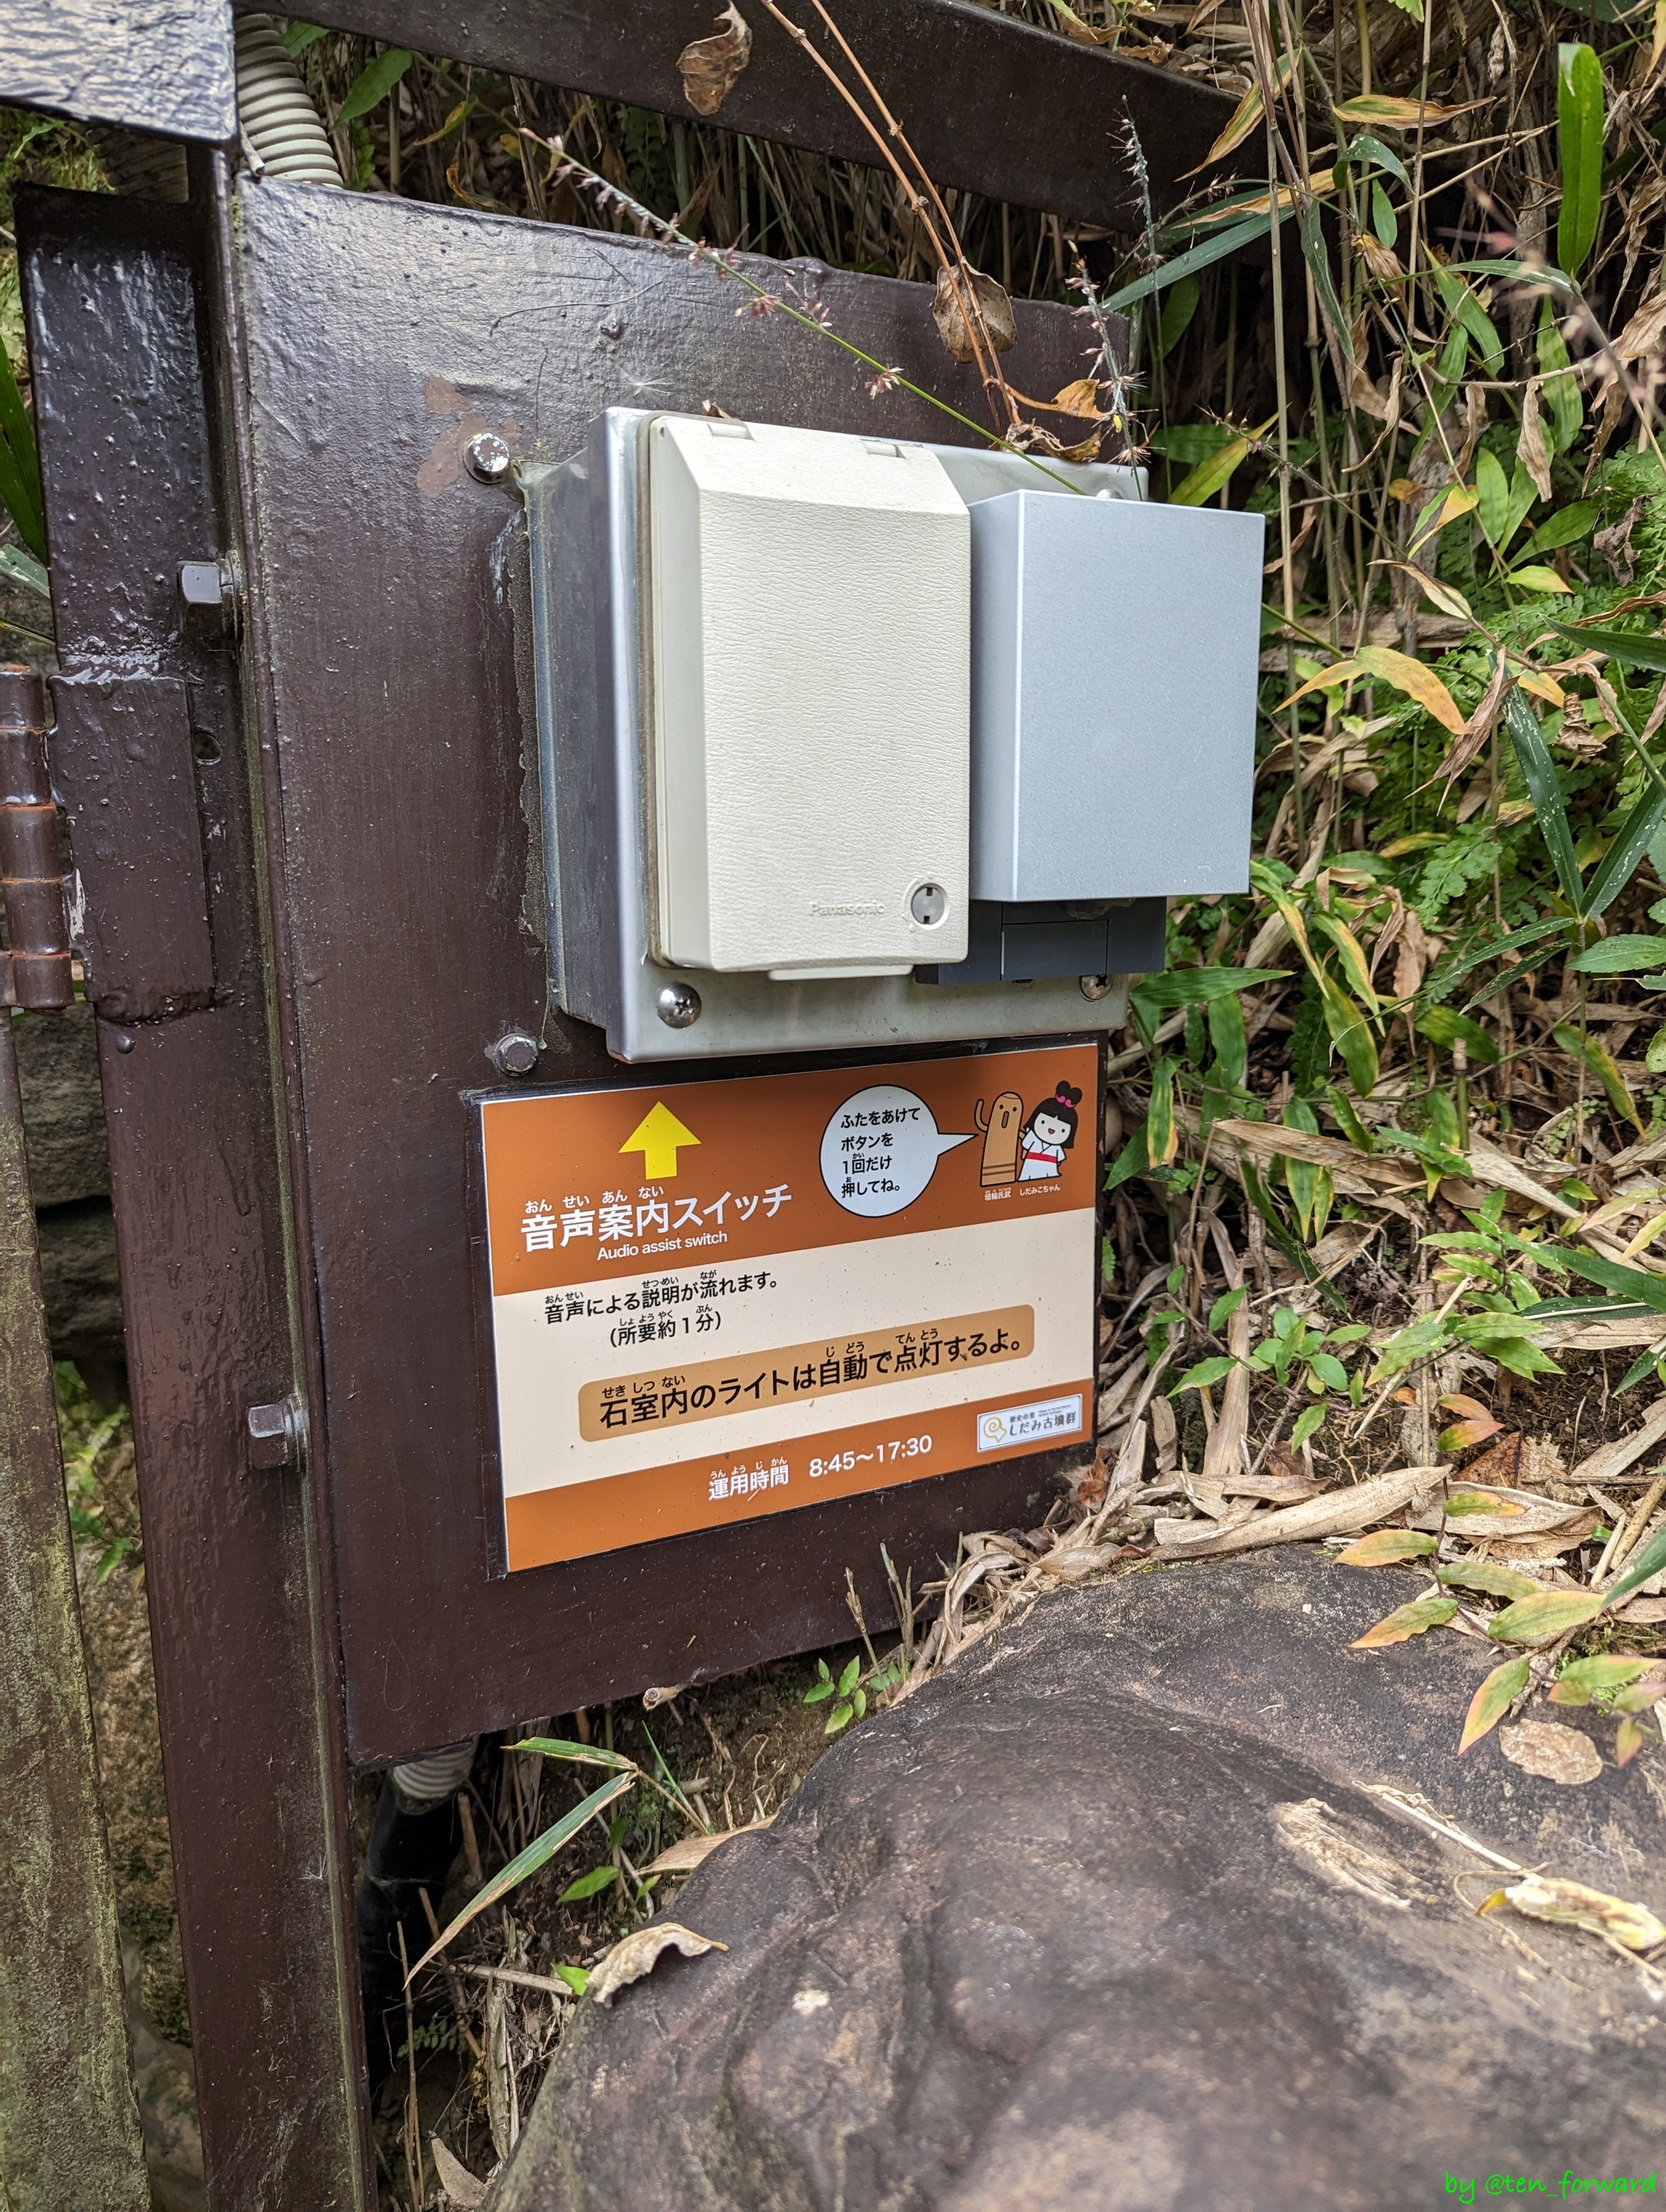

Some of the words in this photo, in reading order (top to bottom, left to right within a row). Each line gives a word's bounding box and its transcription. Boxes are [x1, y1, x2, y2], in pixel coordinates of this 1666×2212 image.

[809, 899, 886, 917] Panasonic
[840, 1107, 921, 1129] ふたをあけて
[841, 1132, 893, 1152] ボタンを
[843, 1155, 892, 1174] 1回だけ
[841, 1178, 901, 1199] 押してね。
[1019, 1184, 1061, 1196] しだみこちゃん
[525, 1200, 552, 1213] おん
[562, 1195, 590, 1208] せい
[602, 1190, 628, 1204] あん
[639, 1186, 665, 1200] ない
[521, 1183, 792, 1252] 音声案内スイッチ
[596, 1244, 639, 1261] Audio
[642, 1238, 682, 1254] assist
[685, 1230, 728, 1248] switch
[700, 1269, 717, 1279] なが
[544, 1271, 778, 1325] 音声による説明が流れます。
[696, 1304, 713, 1313] ぶん
[600, 1328, 1020, 1429] 石室内のライトは自動で点灯するよ。
[602, 1384, 626, 1398] せき
[633, 1380, 656, 1393] しつ
[661, 1375, 686, 1388] ない
[826, 1346, 835, 1357] じ
[846, 1341, 865, 1353] どう
[710, 1470, 726, 1478] うん
[731, 1465, 747, 1475] よう
[756, 1461, 763, 1470] じ
[770, 1457, 787, 1466] かん
[709, 1465, 789, 1501] 運用時間
